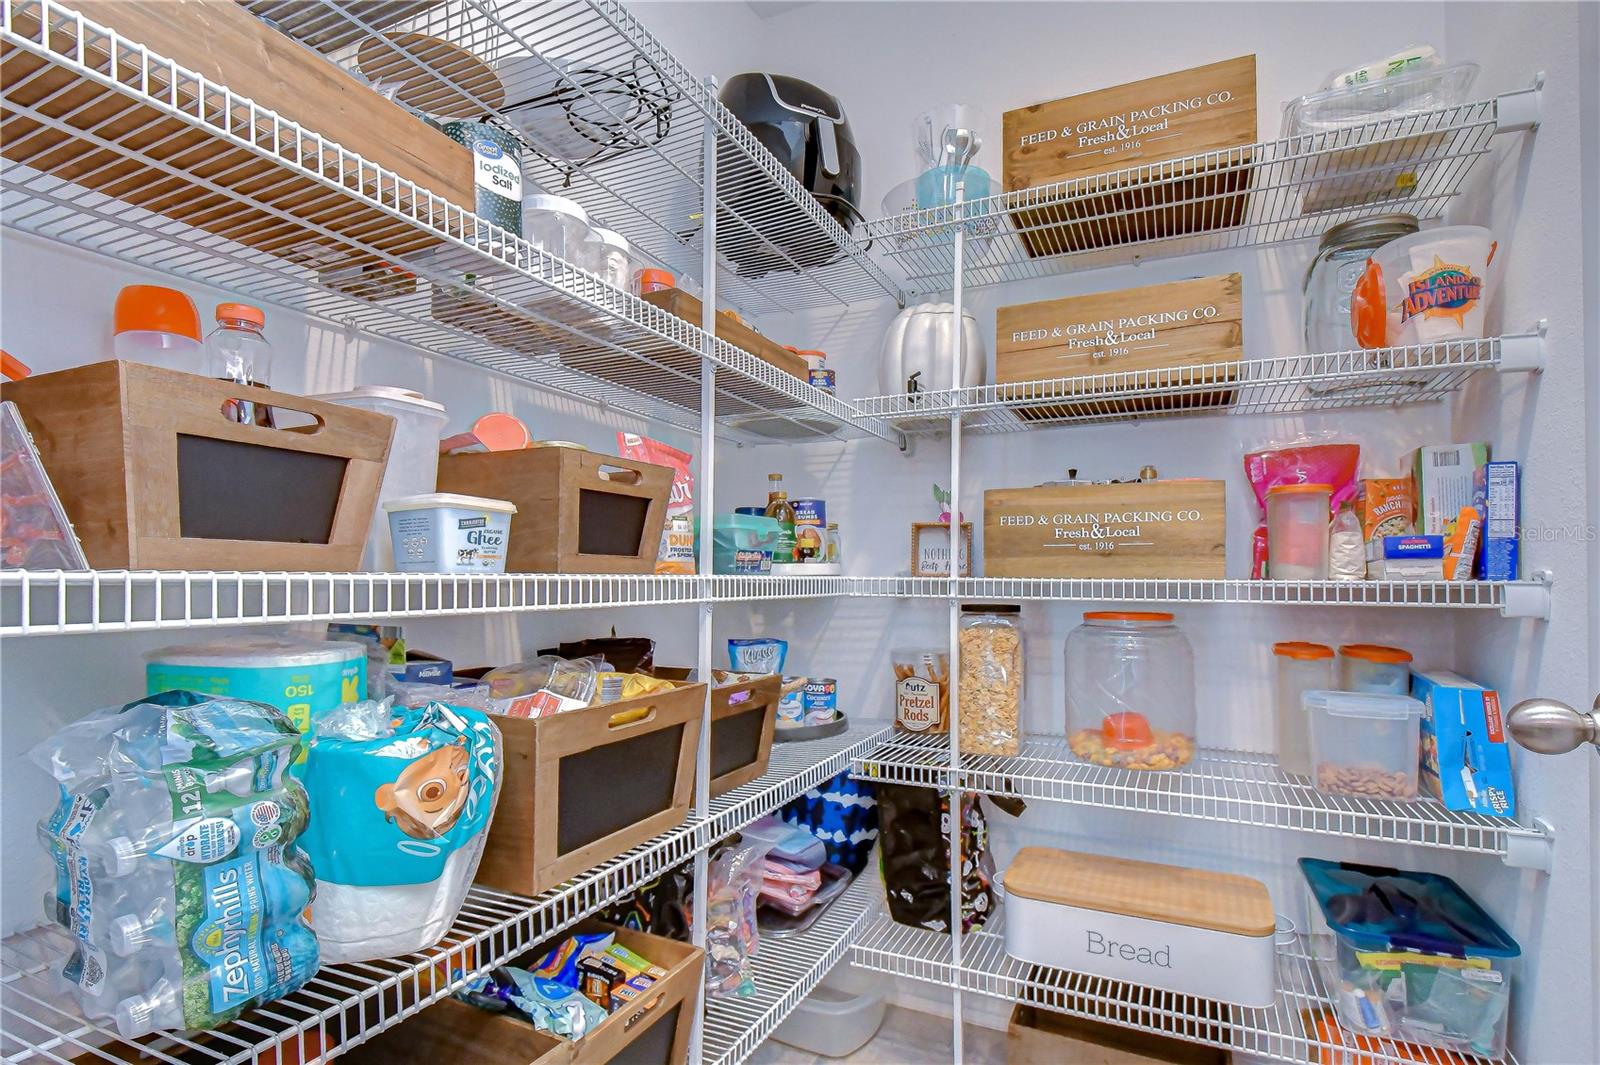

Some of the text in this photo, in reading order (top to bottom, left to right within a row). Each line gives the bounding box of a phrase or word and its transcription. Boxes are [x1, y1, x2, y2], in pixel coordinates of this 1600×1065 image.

[1020, 90, 1235, 147] FEED & GRAIN PACKING CO.
[1103, 140, 1141, 155] est. 1916
[480, 160, 520, 185] Iodized
[492, 174, 513, 190] Salt
[1012, 306, 1220, 342] FEED & GRAIN PACKING CO.
[1092, 346, 1129, 359] est. 1916
[1372, 500, 1401, 516] RANCH
[1000, 510, 1204, 526] FEED & GRAIN PACKING CO.
[466, 530, 502, 546] Ghee
[1095, 542, 1114, 550] 1916
[924, 548, 965, 560] NOTHIG
[285, 684, 314, 698] 150
[900, 694, 934, 708] Pretzel
[904, 708, 929, 722] Rods
[180, 790, 202, 814] 12
[1488, 786, 1504, 814] CRISPY
[1497, 790, 1509, 809] RICE
[200, 824, 210, 860] HYDRATE
[244, 861, 255, 885] WATER
[247, 886, 259, 913] SPRING
[212, 868, 250, 1002] Zephyrhills
[248, 941, 261, 972] NATURAL
[1086, 930, 1172, 969] Bread
